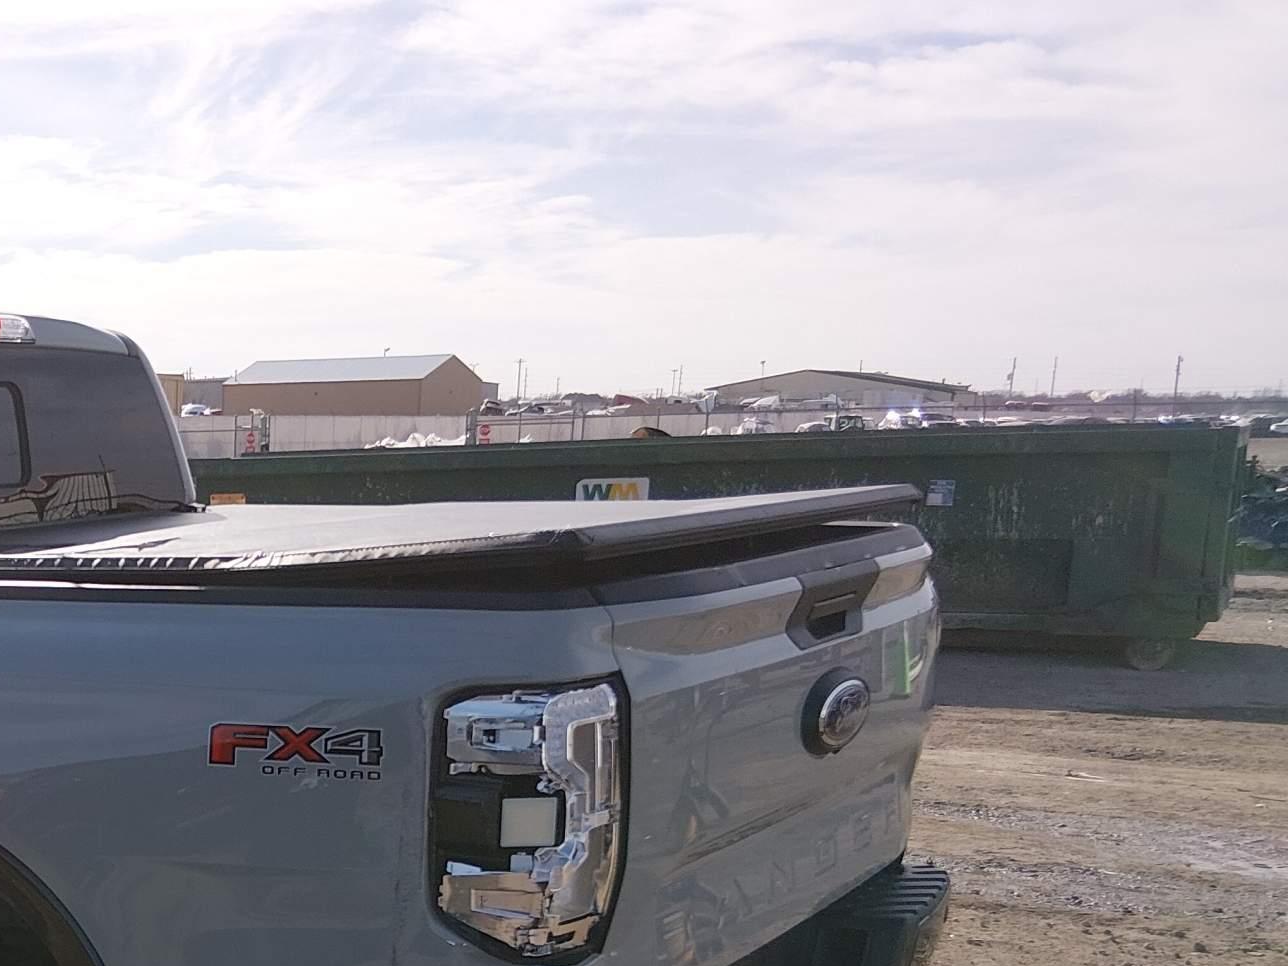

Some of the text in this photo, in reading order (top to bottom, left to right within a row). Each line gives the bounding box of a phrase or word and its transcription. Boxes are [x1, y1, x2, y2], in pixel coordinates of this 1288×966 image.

[582, 483, 640, 501] WM
[208, 721, 384, 767] FX4
[262, 765, 382, 781] OFF ROAD
